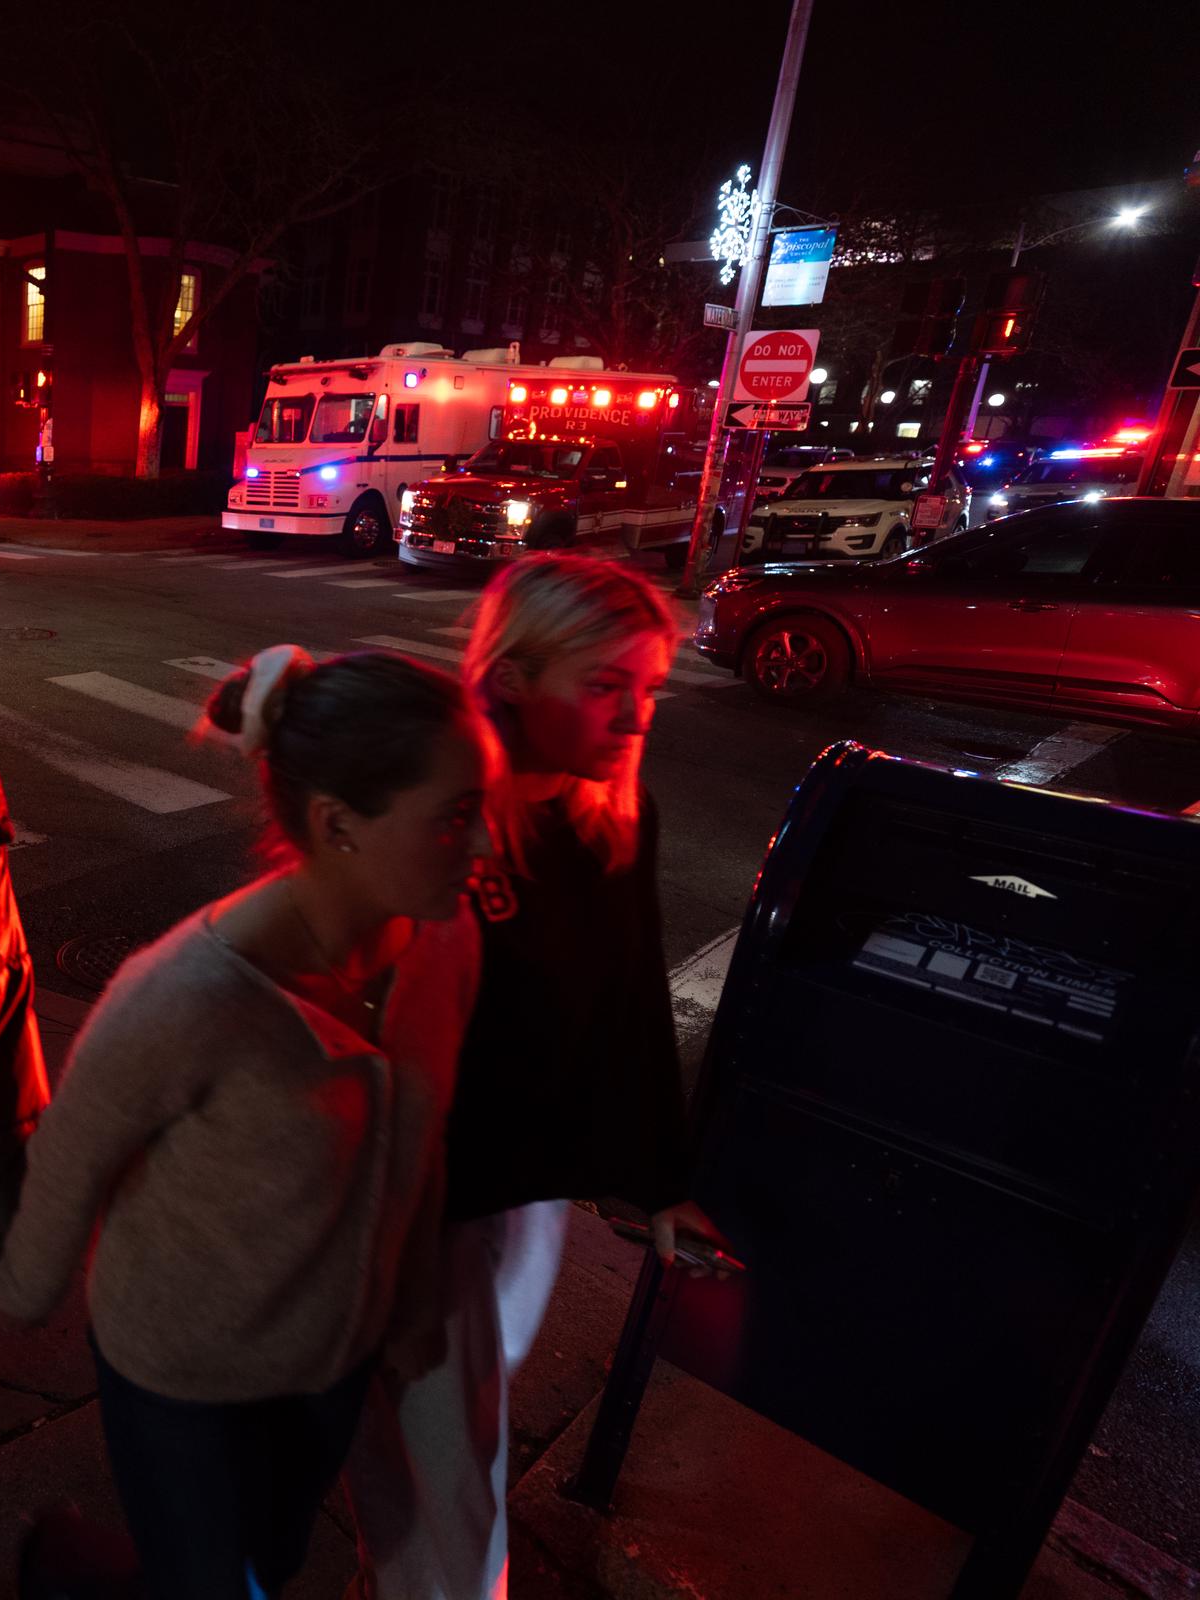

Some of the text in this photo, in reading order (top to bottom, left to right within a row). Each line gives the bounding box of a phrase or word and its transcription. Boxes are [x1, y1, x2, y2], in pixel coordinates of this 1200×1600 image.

[753, 344, 804, 356] DO NOT
[752, 375, 792, 387] ENTER
[529, 406, 631, 427] PROVIDENCE
[993, 878, 1031, 894] MAIL
[928, 939, 1049, 979] COLLECTION
[1055, 975, 1118, 997] TIMES
